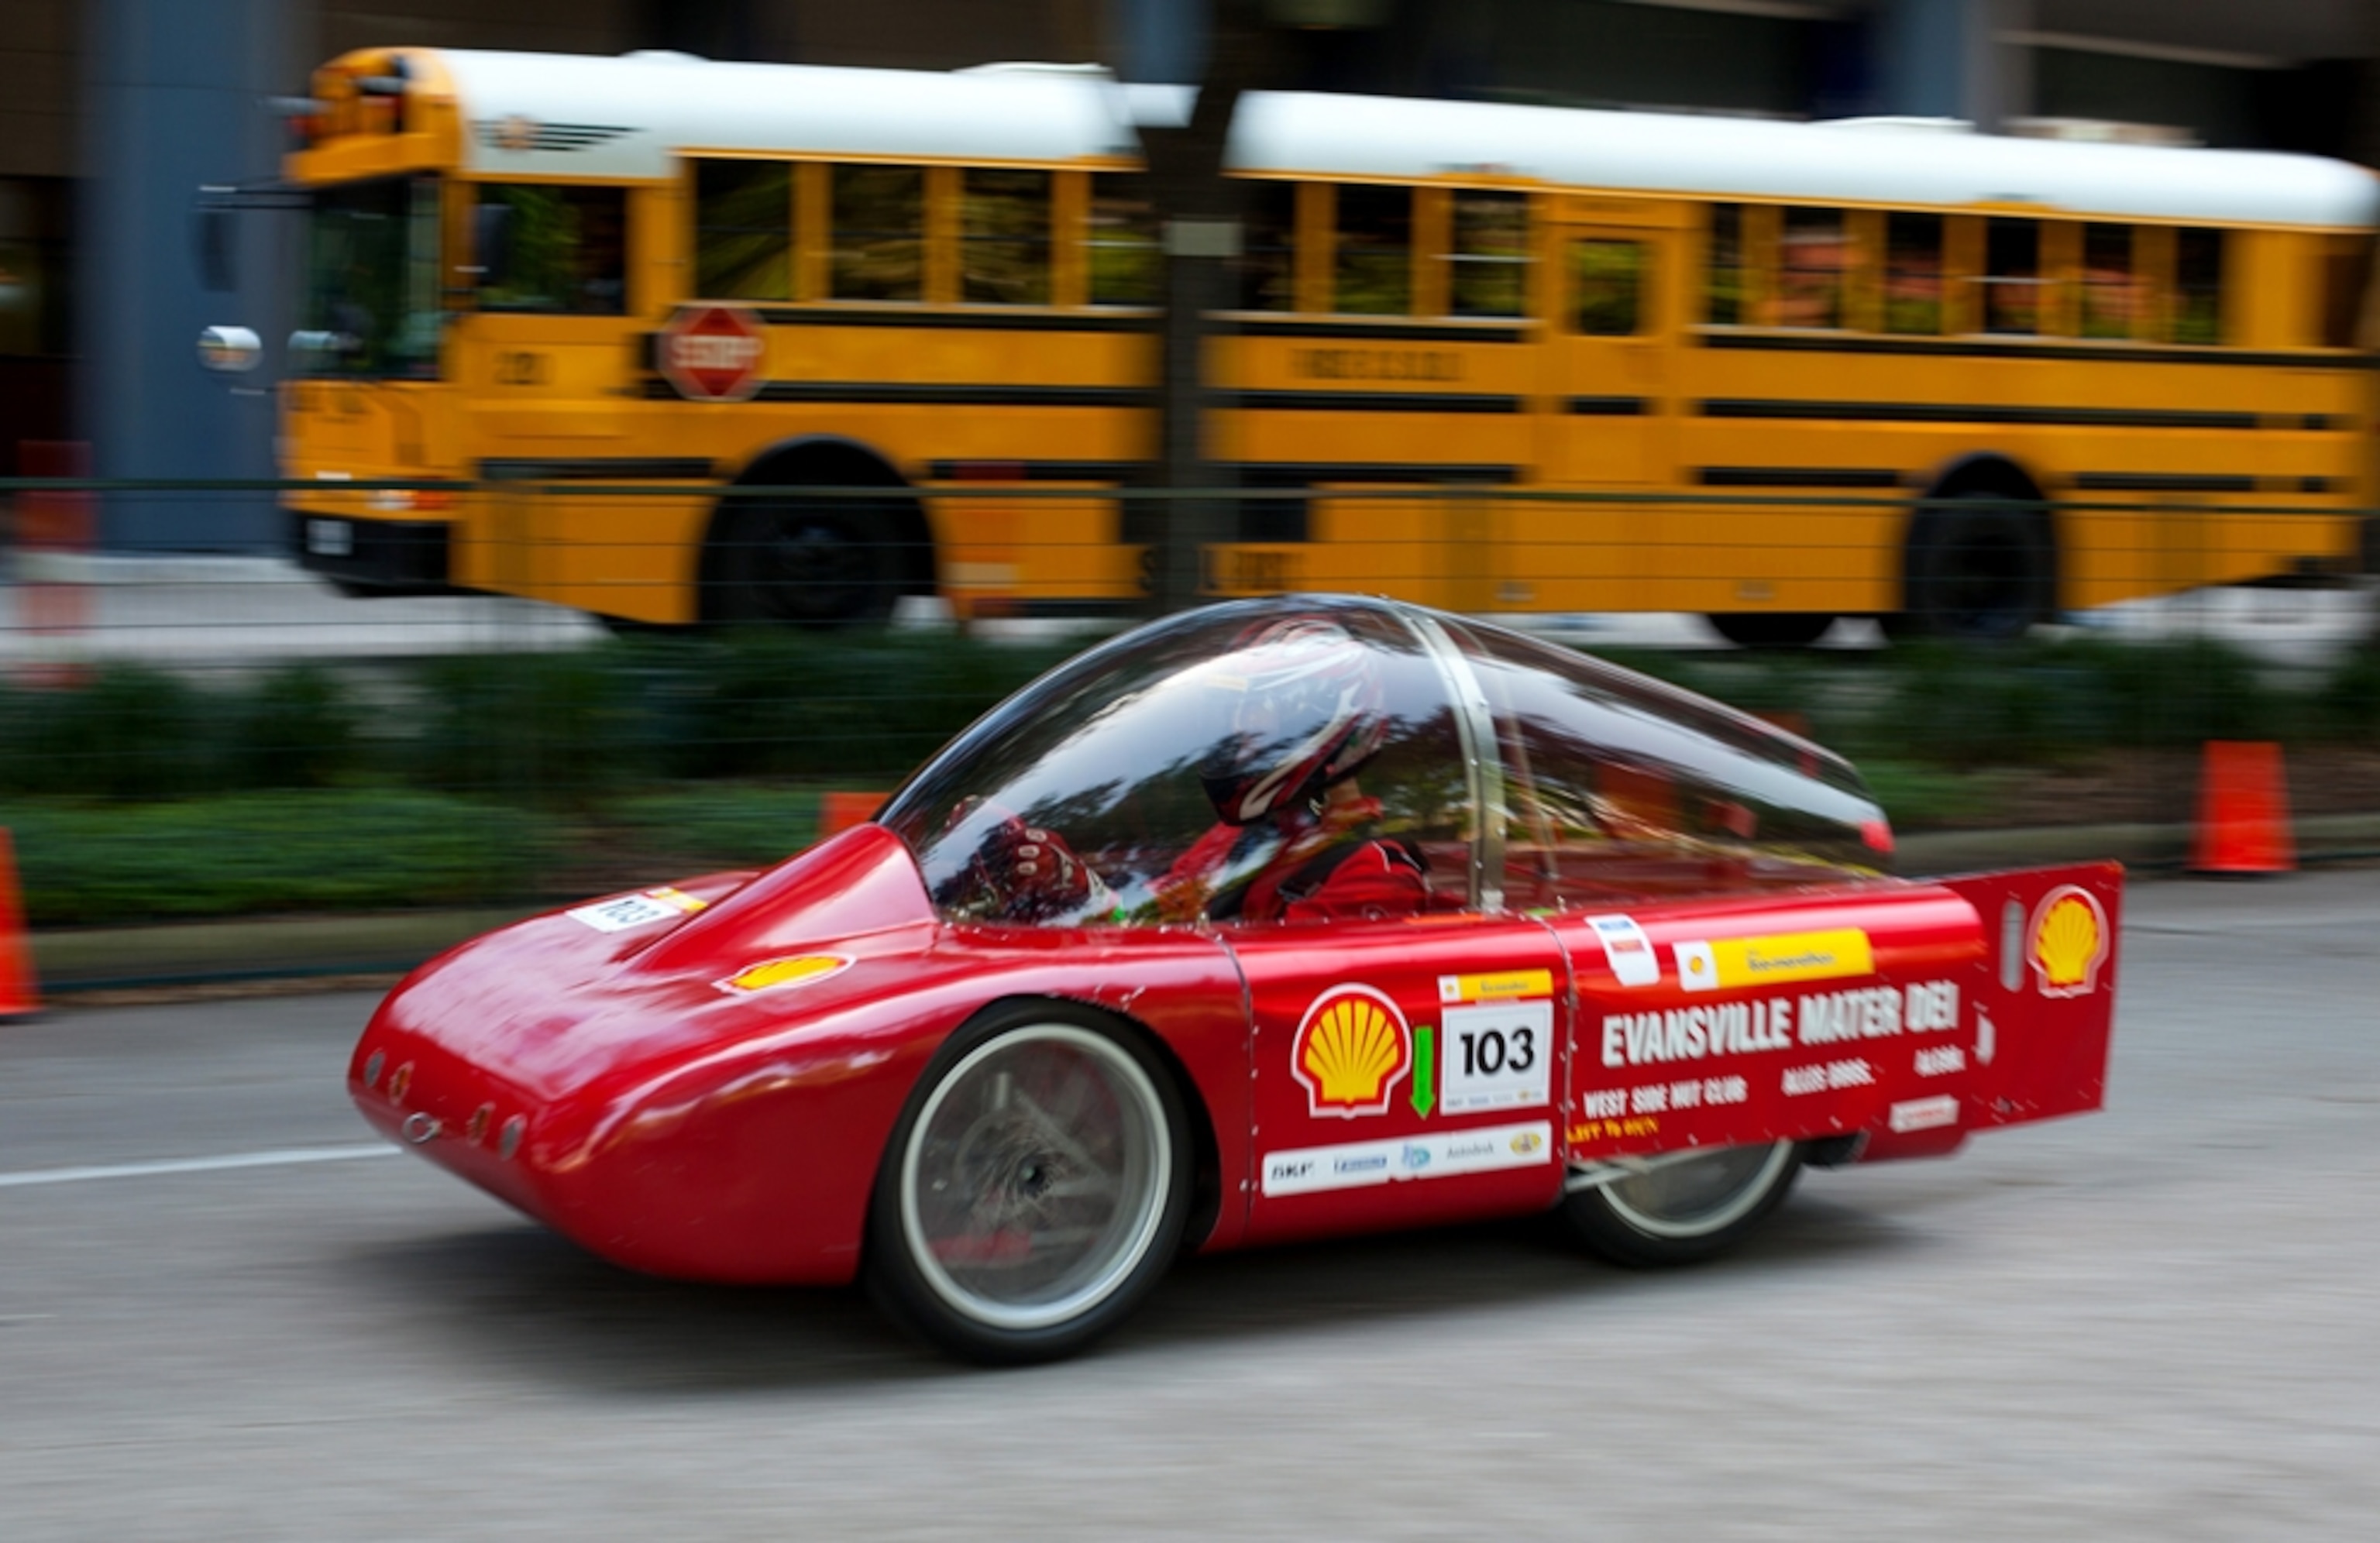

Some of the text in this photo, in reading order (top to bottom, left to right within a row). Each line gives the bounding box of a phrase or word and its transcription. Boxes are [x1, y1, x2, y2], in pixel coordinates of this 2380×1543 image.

[1601, 980, 1959, 1067] EVANSVILLE MATER DEI
[1460, 1026, 1535, 1077] 103
[1583, 1088, 1628, 1119] WEST
[1630, 1083, 1668, 1114] SIDE
[1703, 1074, 1748, 1105] CLUB
